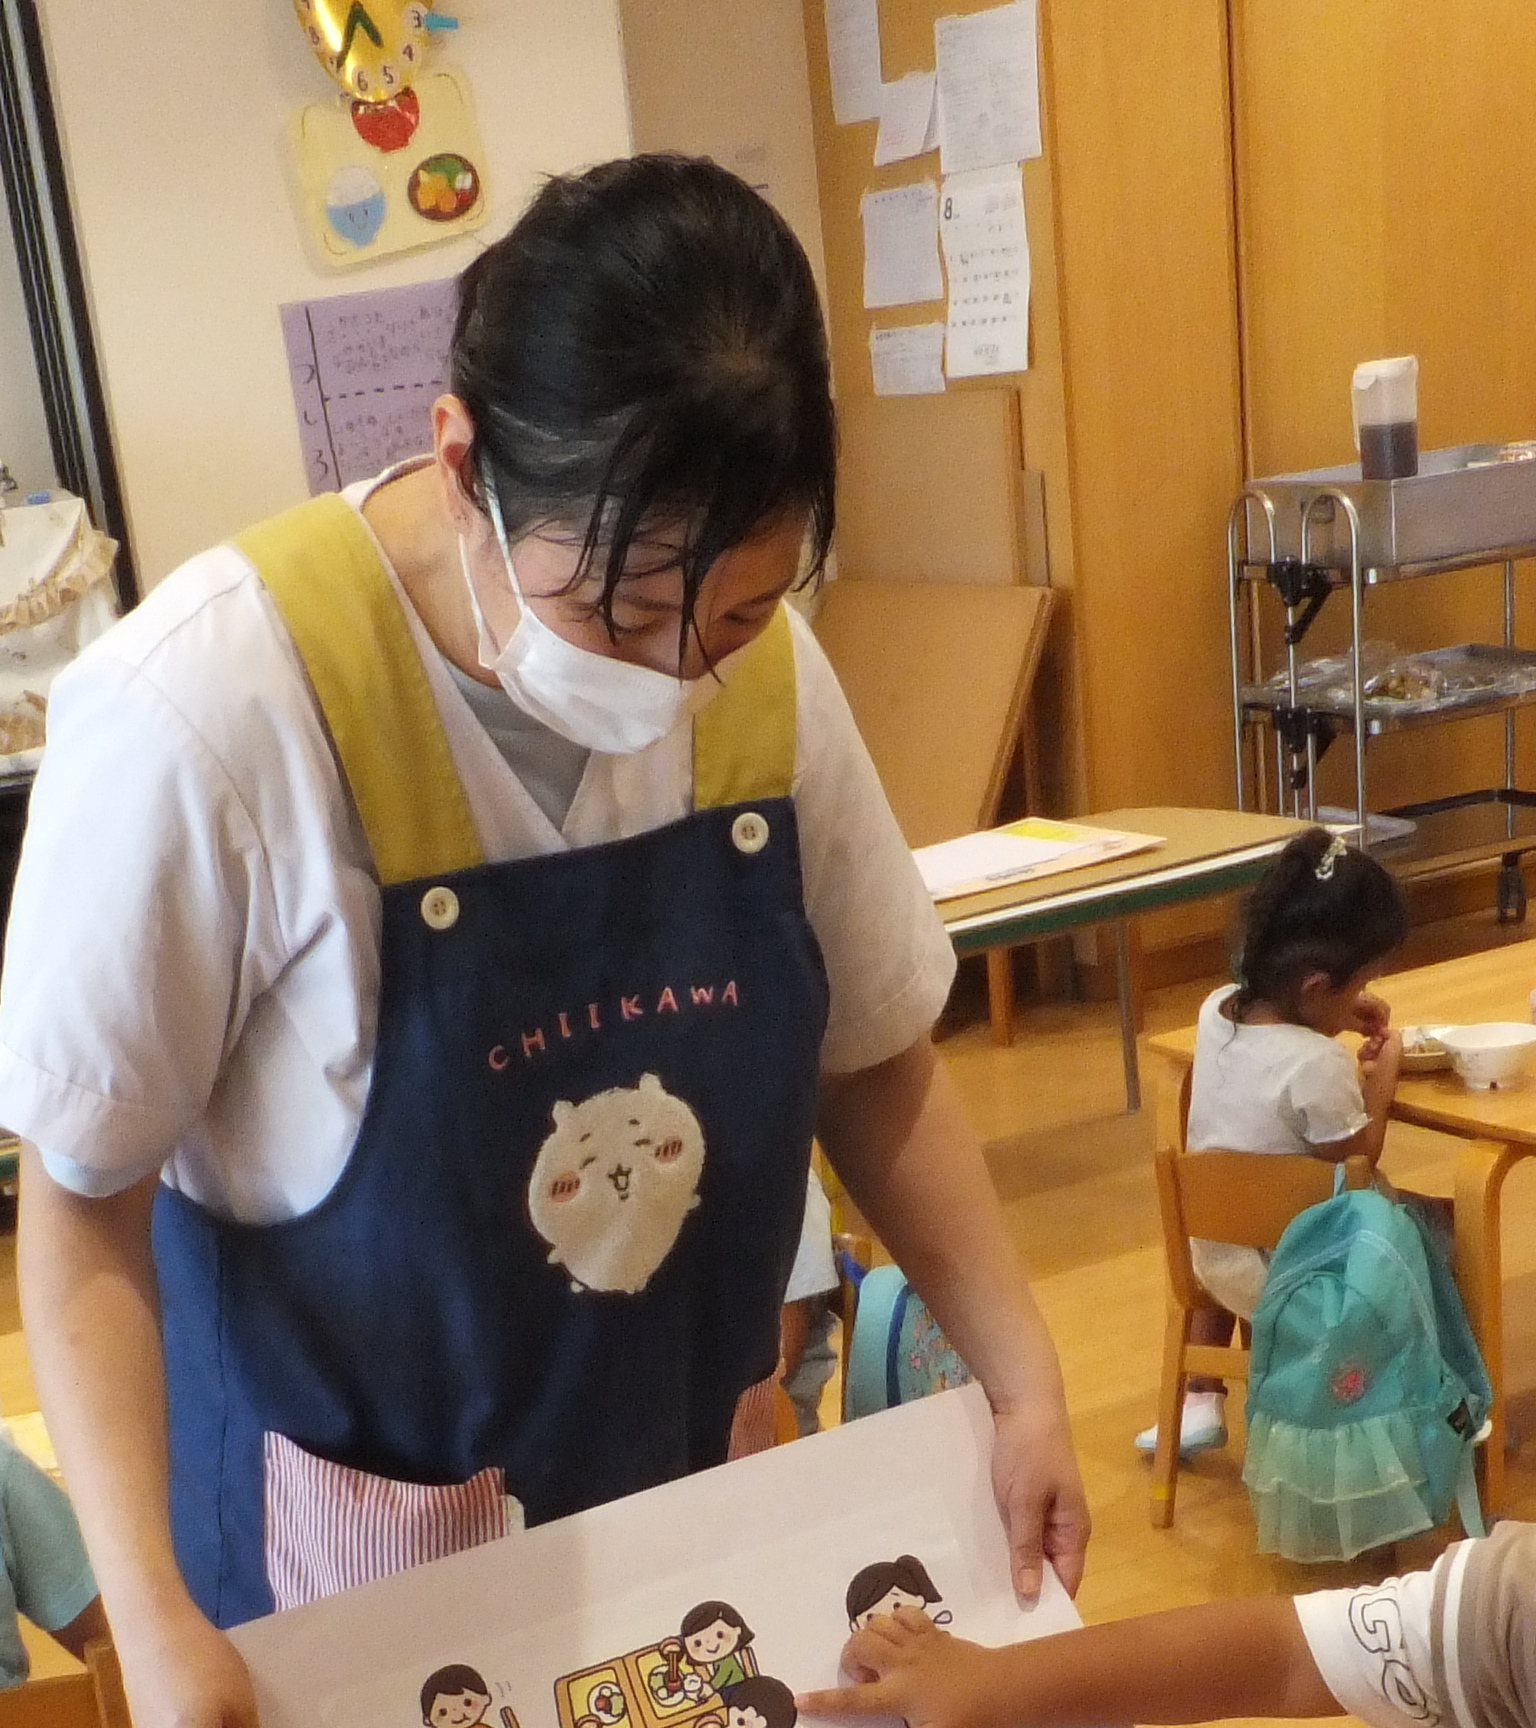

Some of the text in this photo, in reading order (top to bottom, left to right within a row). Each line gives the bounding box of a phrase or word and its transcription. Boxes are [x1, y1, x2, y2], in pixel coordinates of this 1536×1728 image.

[357, 70, 368, 91] 6
[382, 65, 394, 84] 5
[943, 197, 953, 220] 8
[488, 980, 738, 1070] CHIIKAWA
